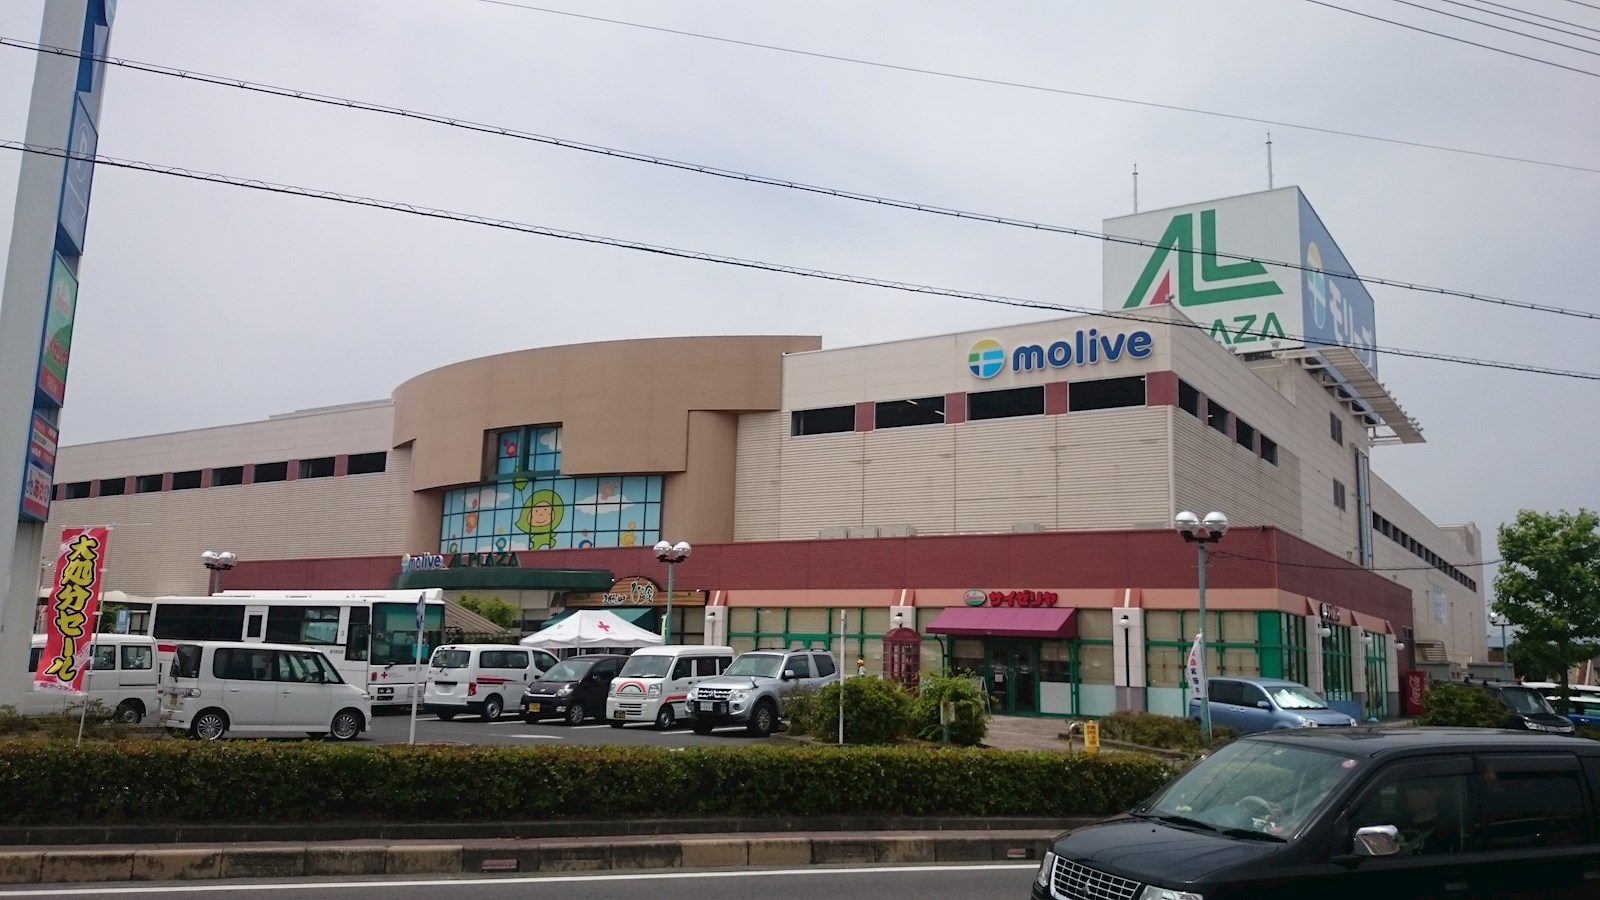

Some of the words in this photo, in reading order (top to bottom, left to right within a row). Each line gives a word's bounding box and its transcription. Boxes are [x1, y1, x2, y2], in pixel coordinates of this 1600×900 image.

[1123, 209, 1284, 308] AL
[1209, 311, 1286, 345] AZA
[1012, 328, 1153, 373] molive
[408, 552, 443, 569] molive
[45, 534, 99, 682] 大処分セール
[989, 590, 1057, 607] サイゼリヤ
